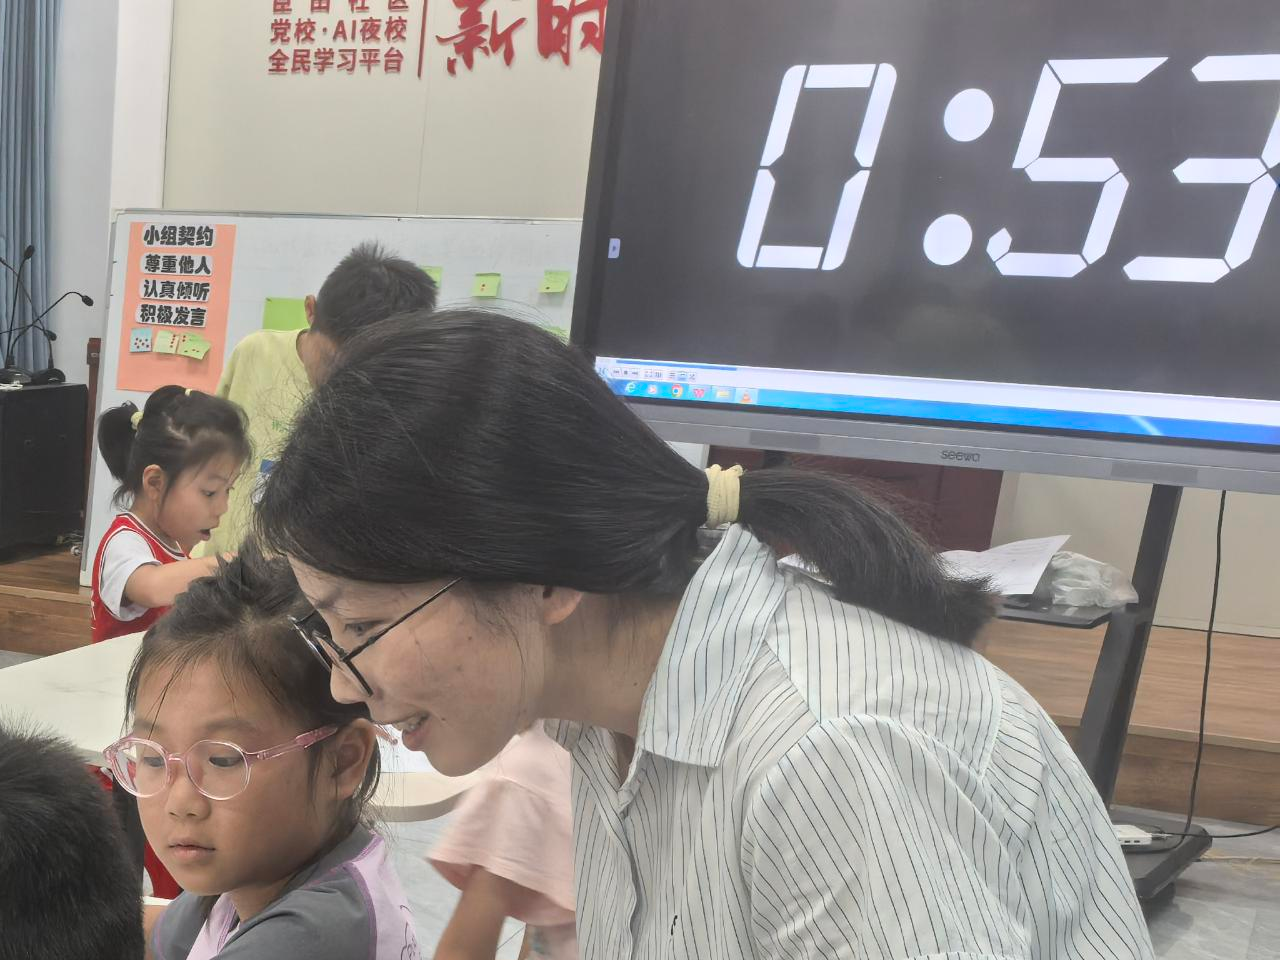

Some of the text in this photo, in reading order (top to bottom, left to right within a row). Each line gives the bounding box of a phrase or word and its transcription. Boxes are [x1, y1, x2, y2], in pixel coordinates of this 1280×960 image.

[270, 17, 408, 43] 党校·AI夜校
[268, 47, 404, 74] 全民学习平台
[737, 57, 1280, 282] 0:53
[143, 225, 214, 246] 小组契约
[144, 254, 211, 275] 尊重他人
[143, 279, 210, 300] 认真倾听
[139, 303, 207, 326] 积极发言
